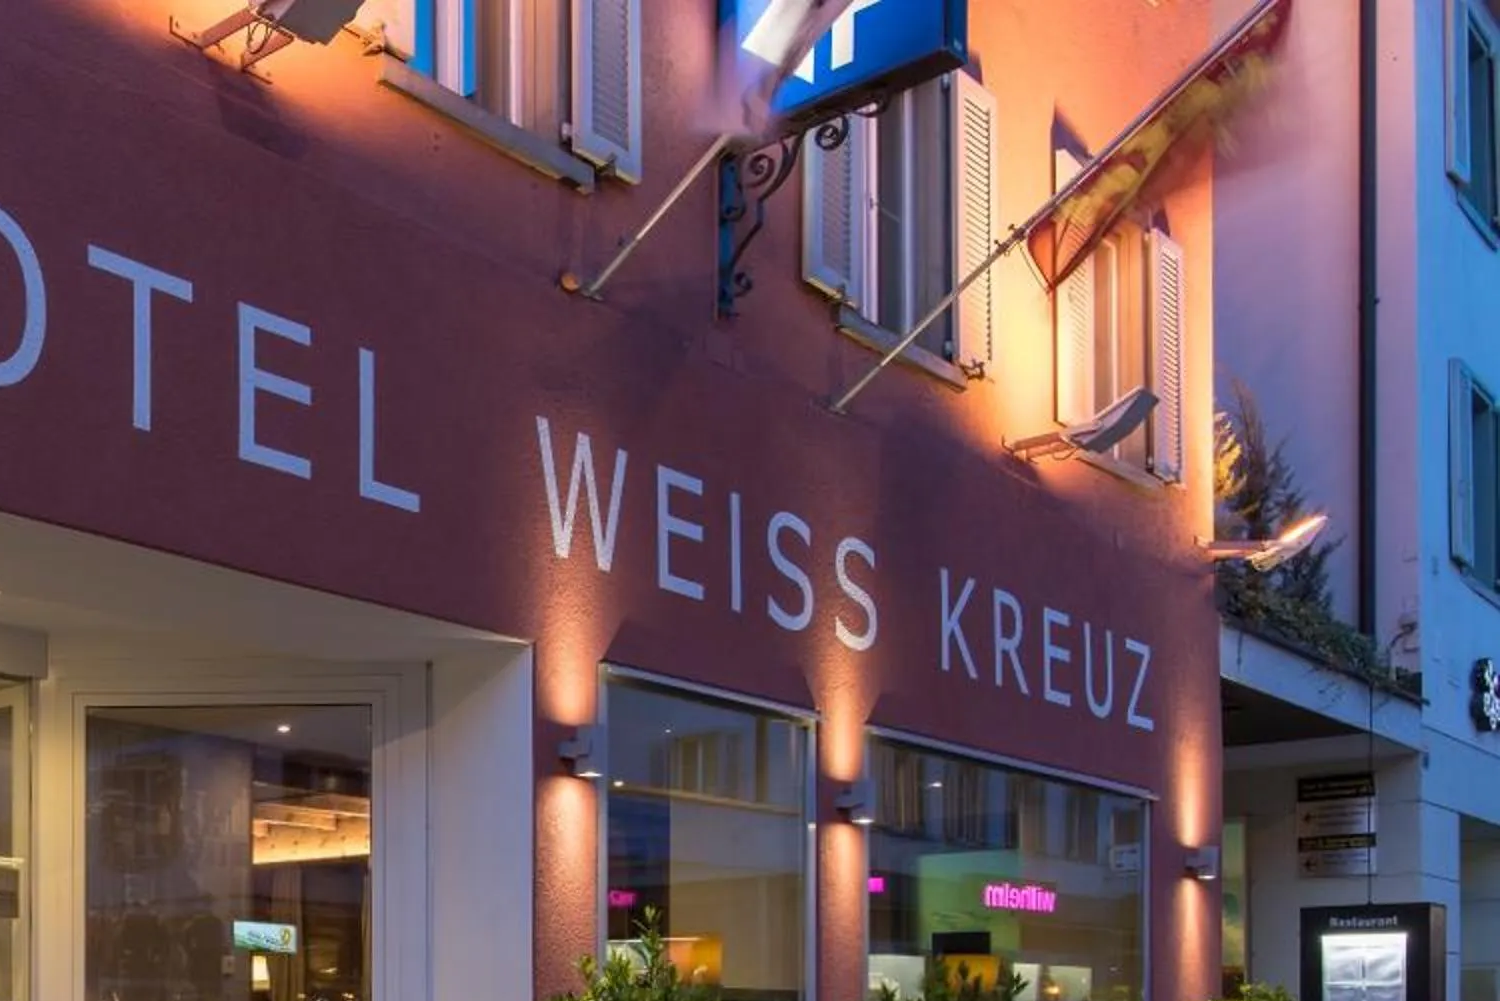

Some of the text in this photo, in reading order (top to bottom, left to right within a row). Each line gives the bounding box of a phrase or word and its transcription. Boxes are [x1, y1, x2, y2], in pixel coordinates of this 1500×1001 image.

[535, 415, 878, 652] WEISS
[940, 567, 1156, 732] KREUZ
[1329, 914, 1398, 928] Restaurant
